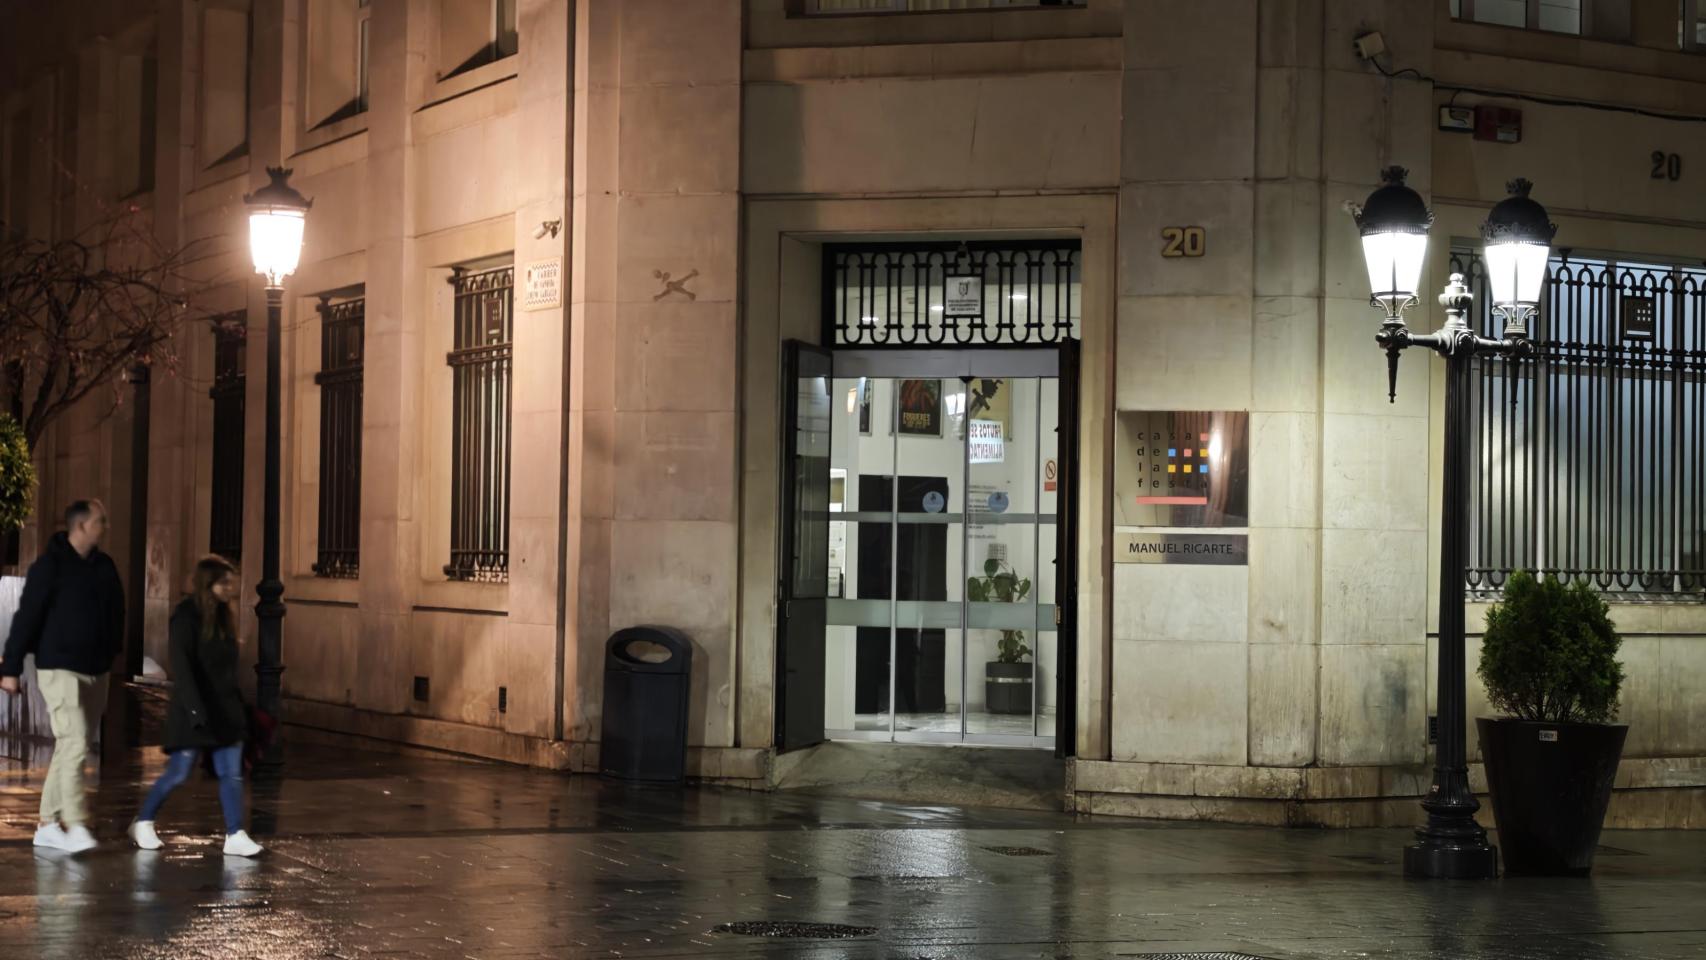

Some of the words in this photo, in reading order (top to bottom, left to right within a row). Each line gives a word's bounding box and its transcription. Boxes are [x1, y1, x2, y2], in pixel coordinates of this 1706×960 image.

[1651, 150, 1682, 182] 20
[1161, 226, 1206, 257] 20
[1136, 446, 1161, 456] de
[1129, 543, 1180, 554] MANUEL
[1183, 543, 1233, 554] RICARTE
